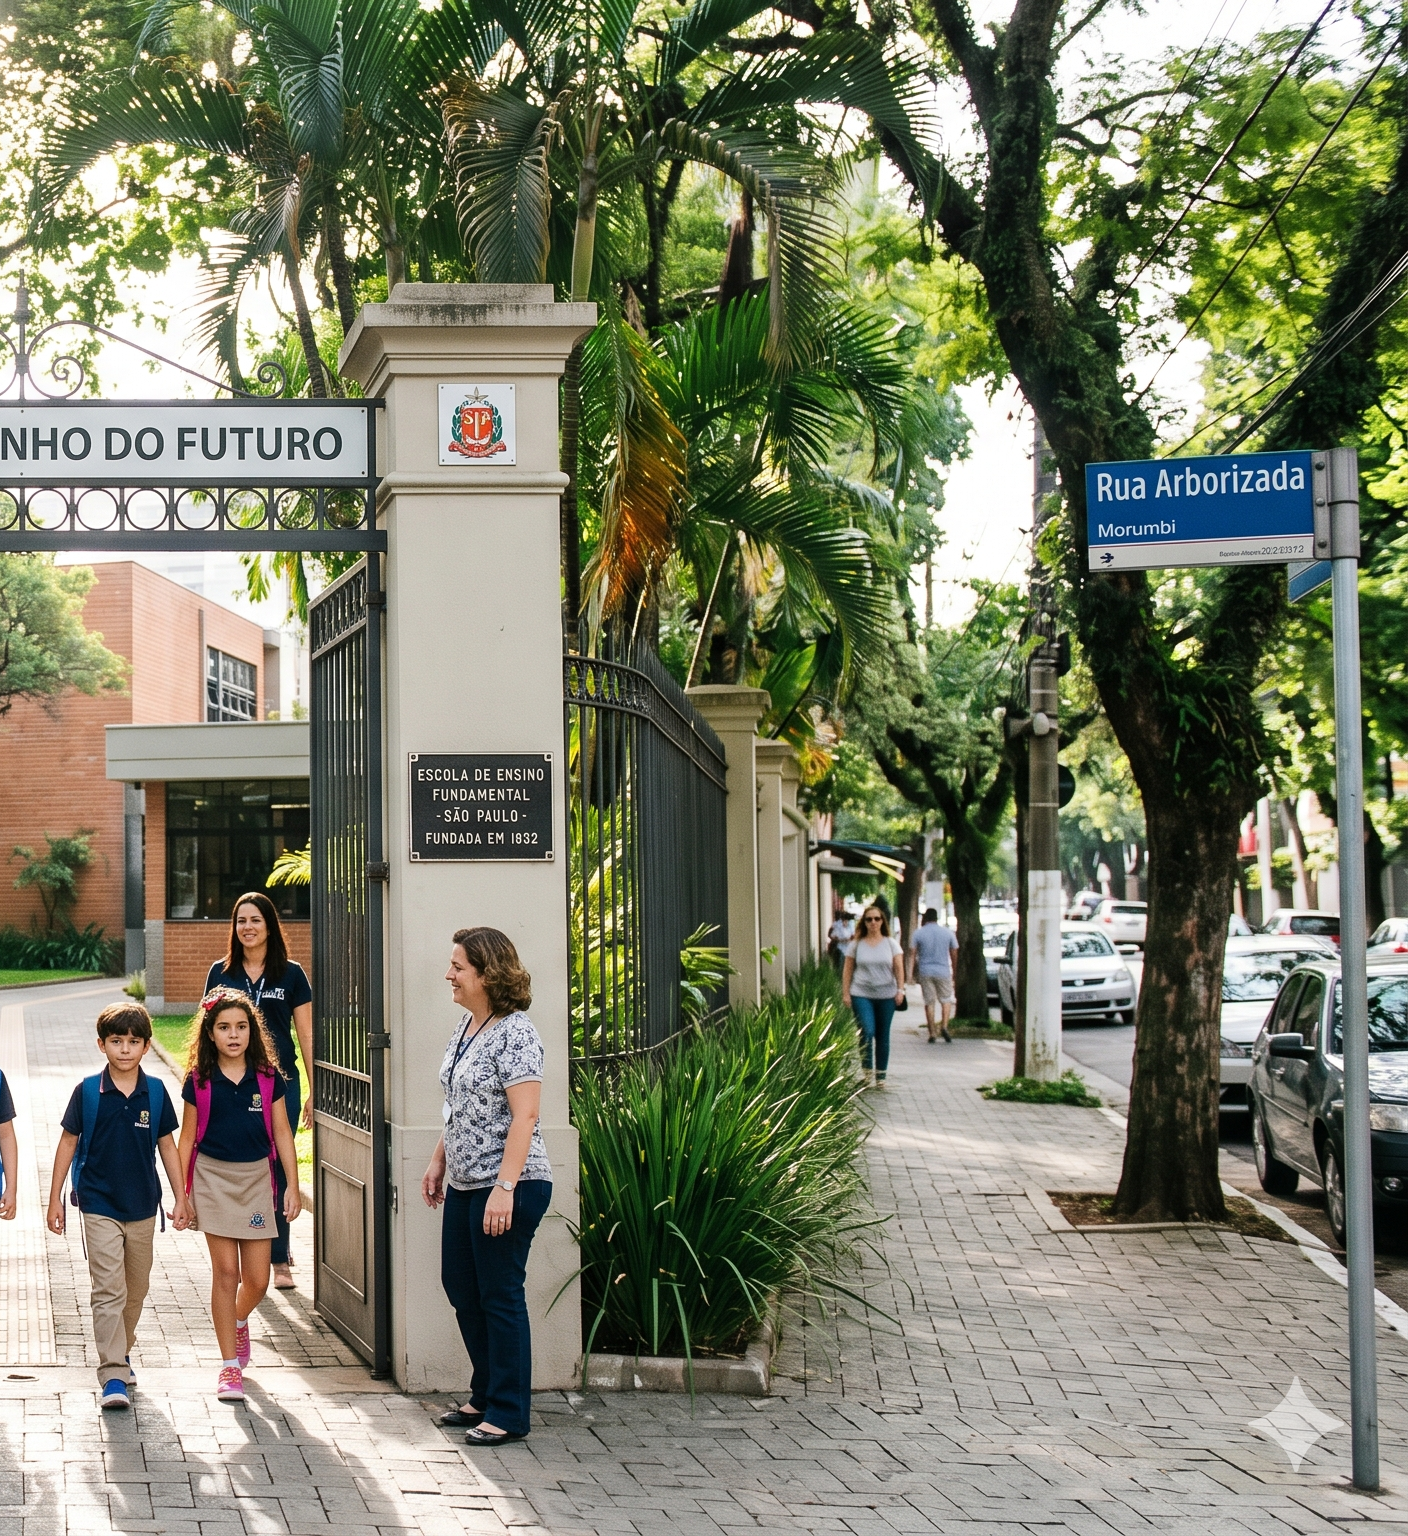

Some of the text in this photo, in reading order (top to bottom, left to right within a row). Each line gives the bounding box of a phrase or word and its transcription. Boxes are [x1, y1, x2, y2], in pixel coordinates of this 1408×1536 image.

[104, 426, 165, 461] DO
[177, 426, 343, 461] FUTURO
[1097, 461, 1305, 502] Rua Arborizada
[1098, 519, 1176, 538] Morumbi
[417, 768, 544, 782] ESCOLA DE ENSINO
[433, 788, 531, 802] FUNDAMENTAL
[425, 831, 538, 845] FUNDADA EM 1832
